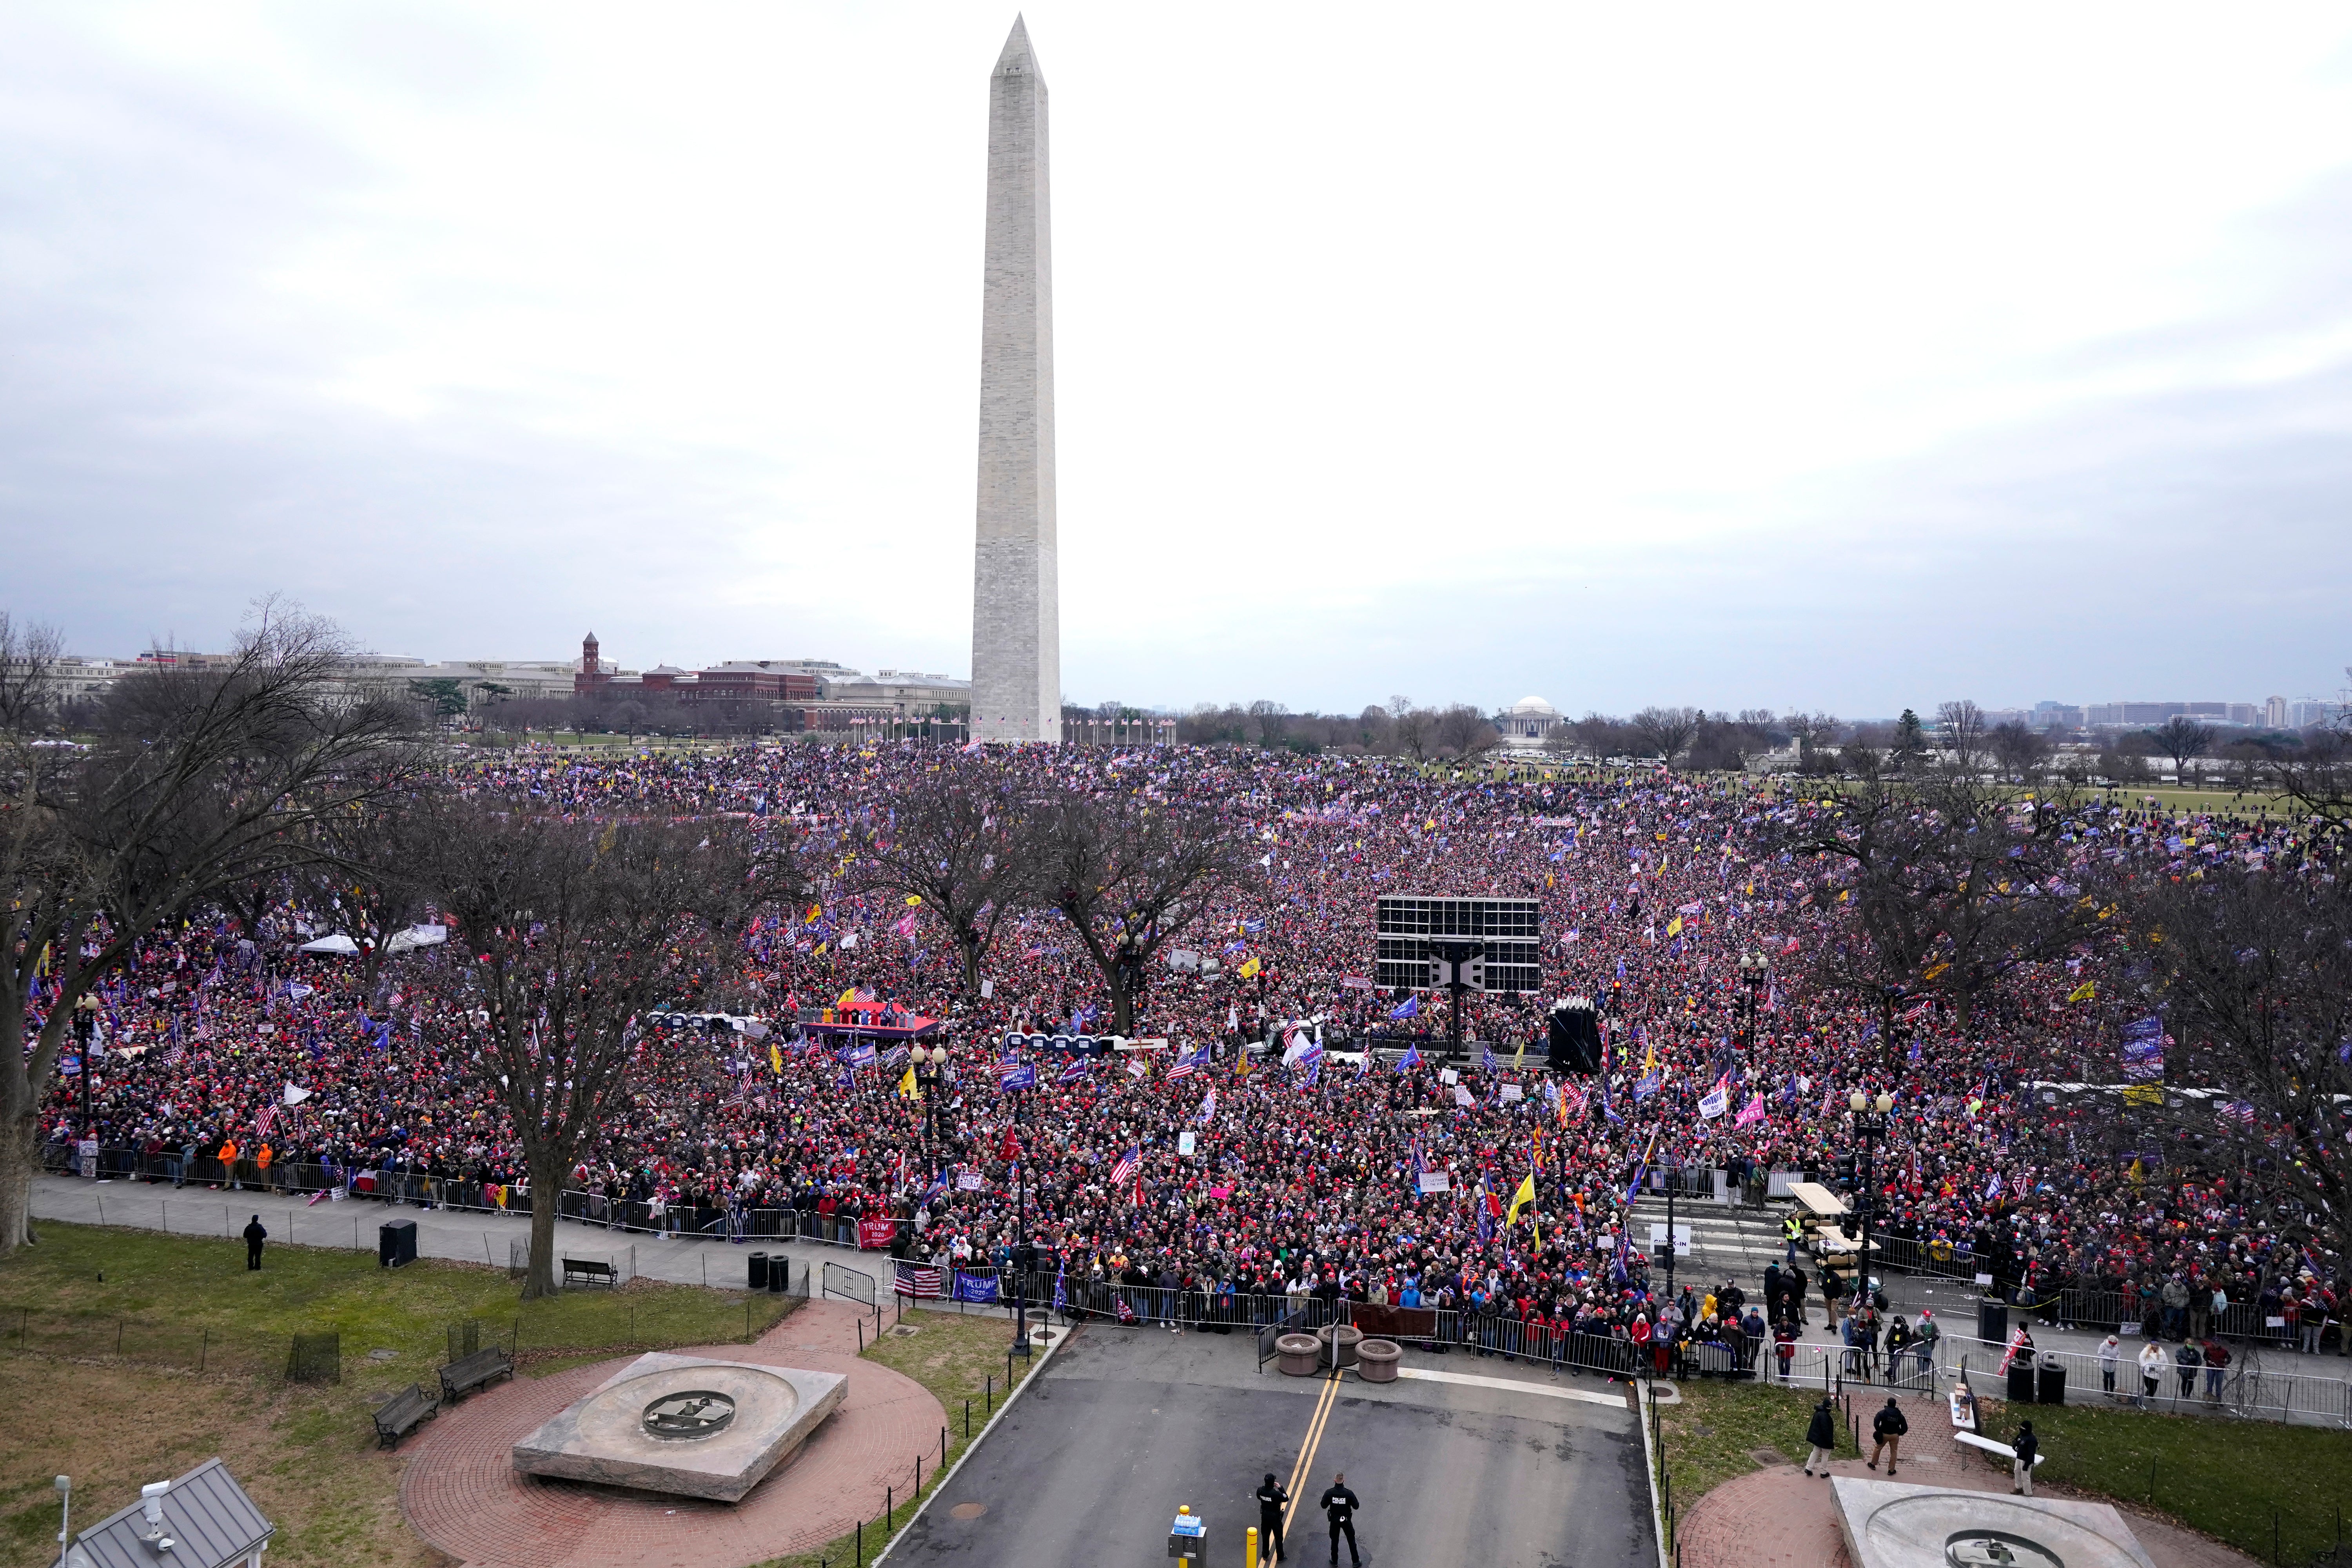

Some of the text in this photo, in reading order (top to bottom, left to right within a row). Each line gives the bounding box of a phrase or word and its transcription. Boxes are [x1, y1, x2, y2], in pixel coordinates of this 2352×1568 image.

[1129, 1063, 1144, 1074] REVOTE
[1563, 1083, 1580, 1100] TRUM
[863, 1221, 891, 1232] TRUM
[961, 1278, 997, 1289] TRUMP
